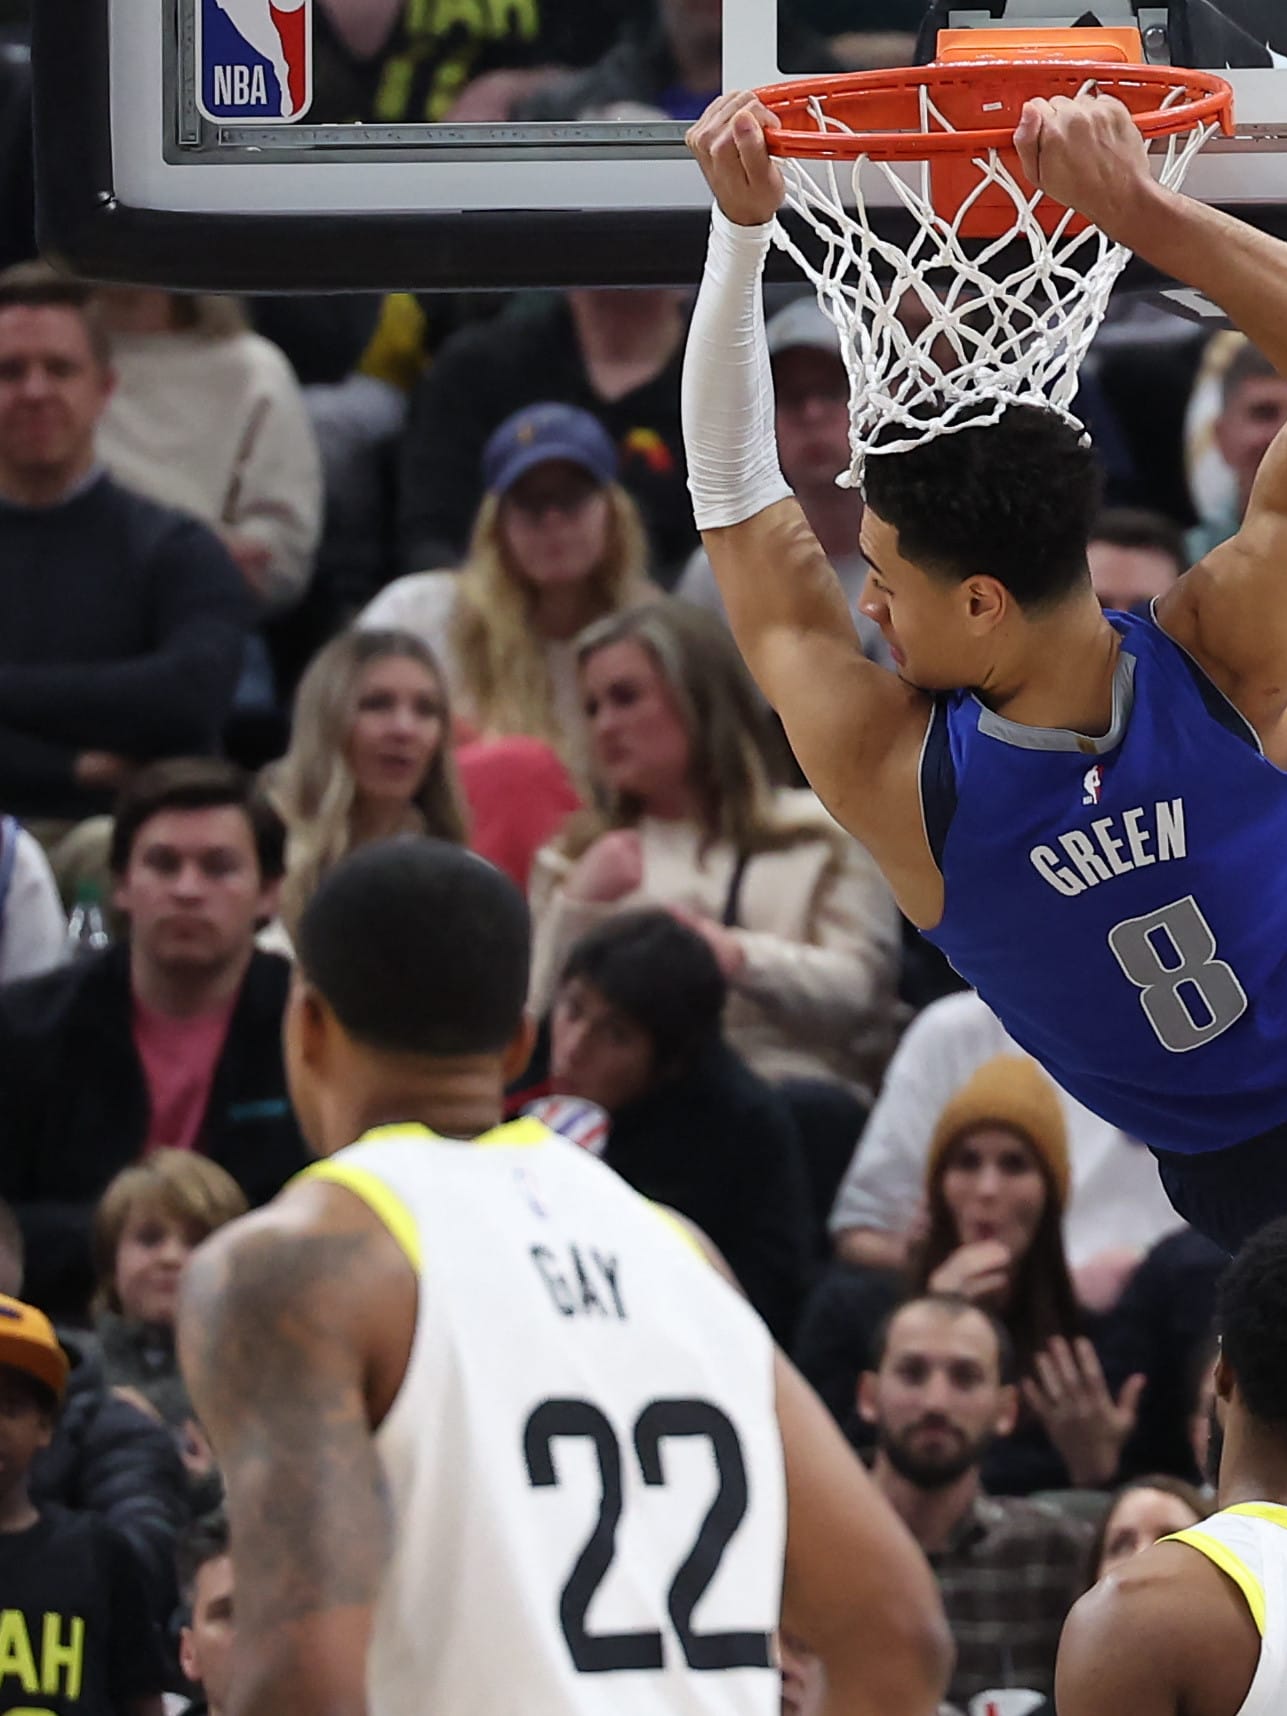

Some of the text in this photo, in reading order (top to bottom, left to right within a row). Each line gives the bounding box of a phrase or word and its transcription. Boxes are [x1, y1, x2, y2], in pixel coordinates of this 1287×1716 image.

[214, 64, 268, 106] NBA
[1029, 797, 1187, 896] GREEN
[1107, 894, 1248, 1053] 8
[529, 1241, 628, 1321] GAY
[523, 1398, 772, 1673] 22
